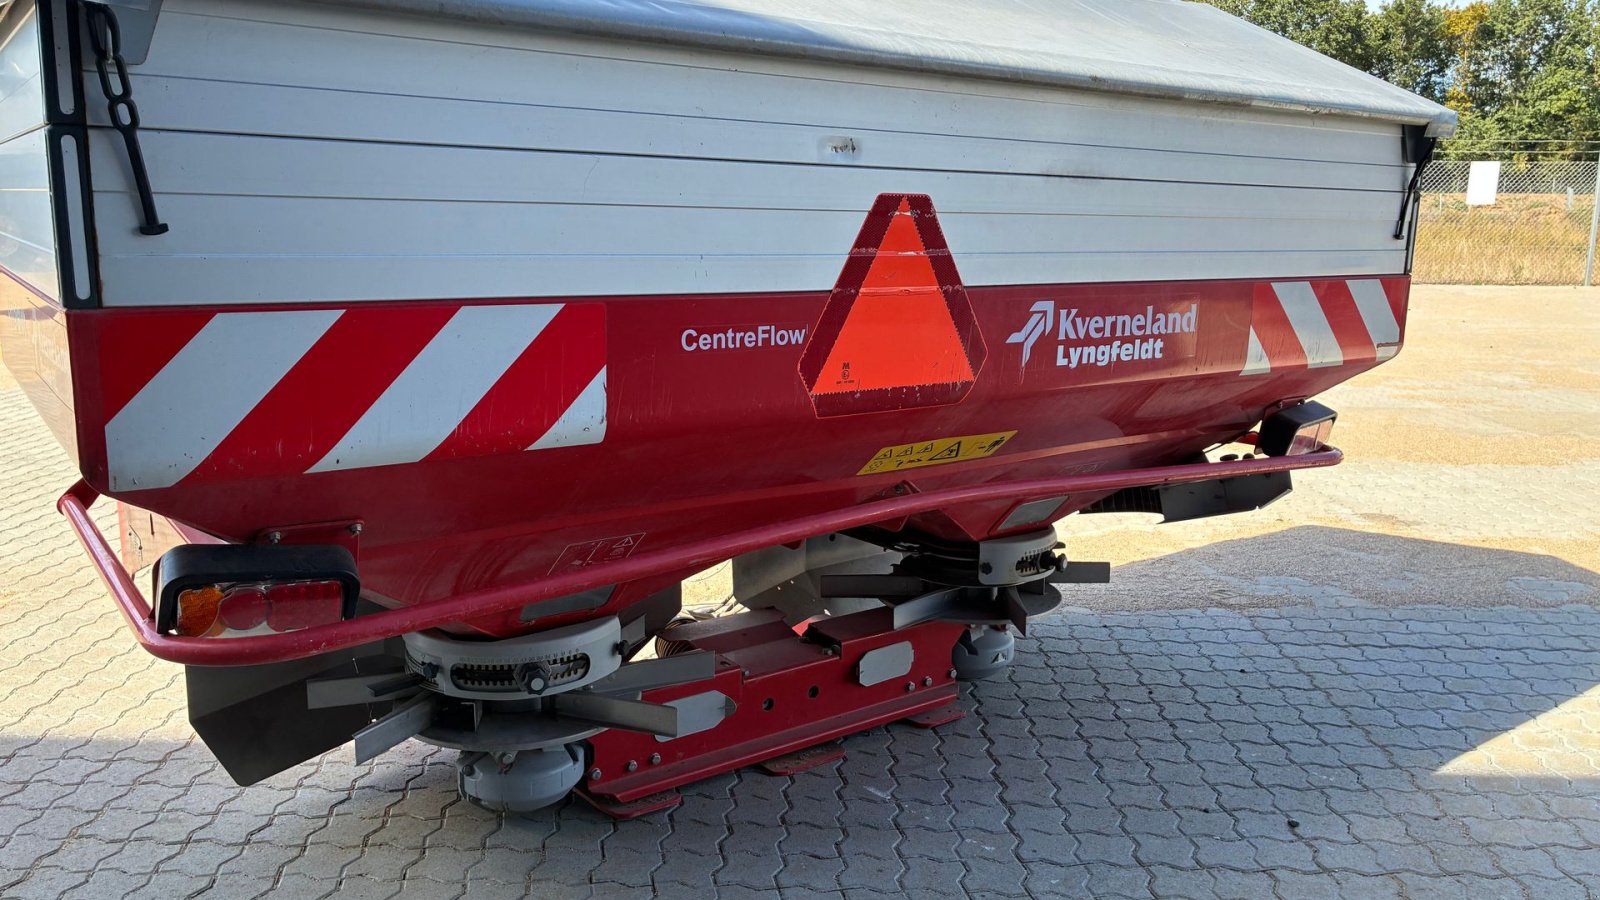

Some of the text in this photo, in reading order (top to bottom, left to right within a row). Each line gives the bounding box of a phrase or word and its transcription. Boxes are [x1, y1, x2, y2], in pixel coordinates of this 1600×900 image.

[1057, 303, 1197, 341] Kverneland
[681, 325, 806, 351] CentreFlow
[1056, 338, 1164, 369] Lyngfeldt
